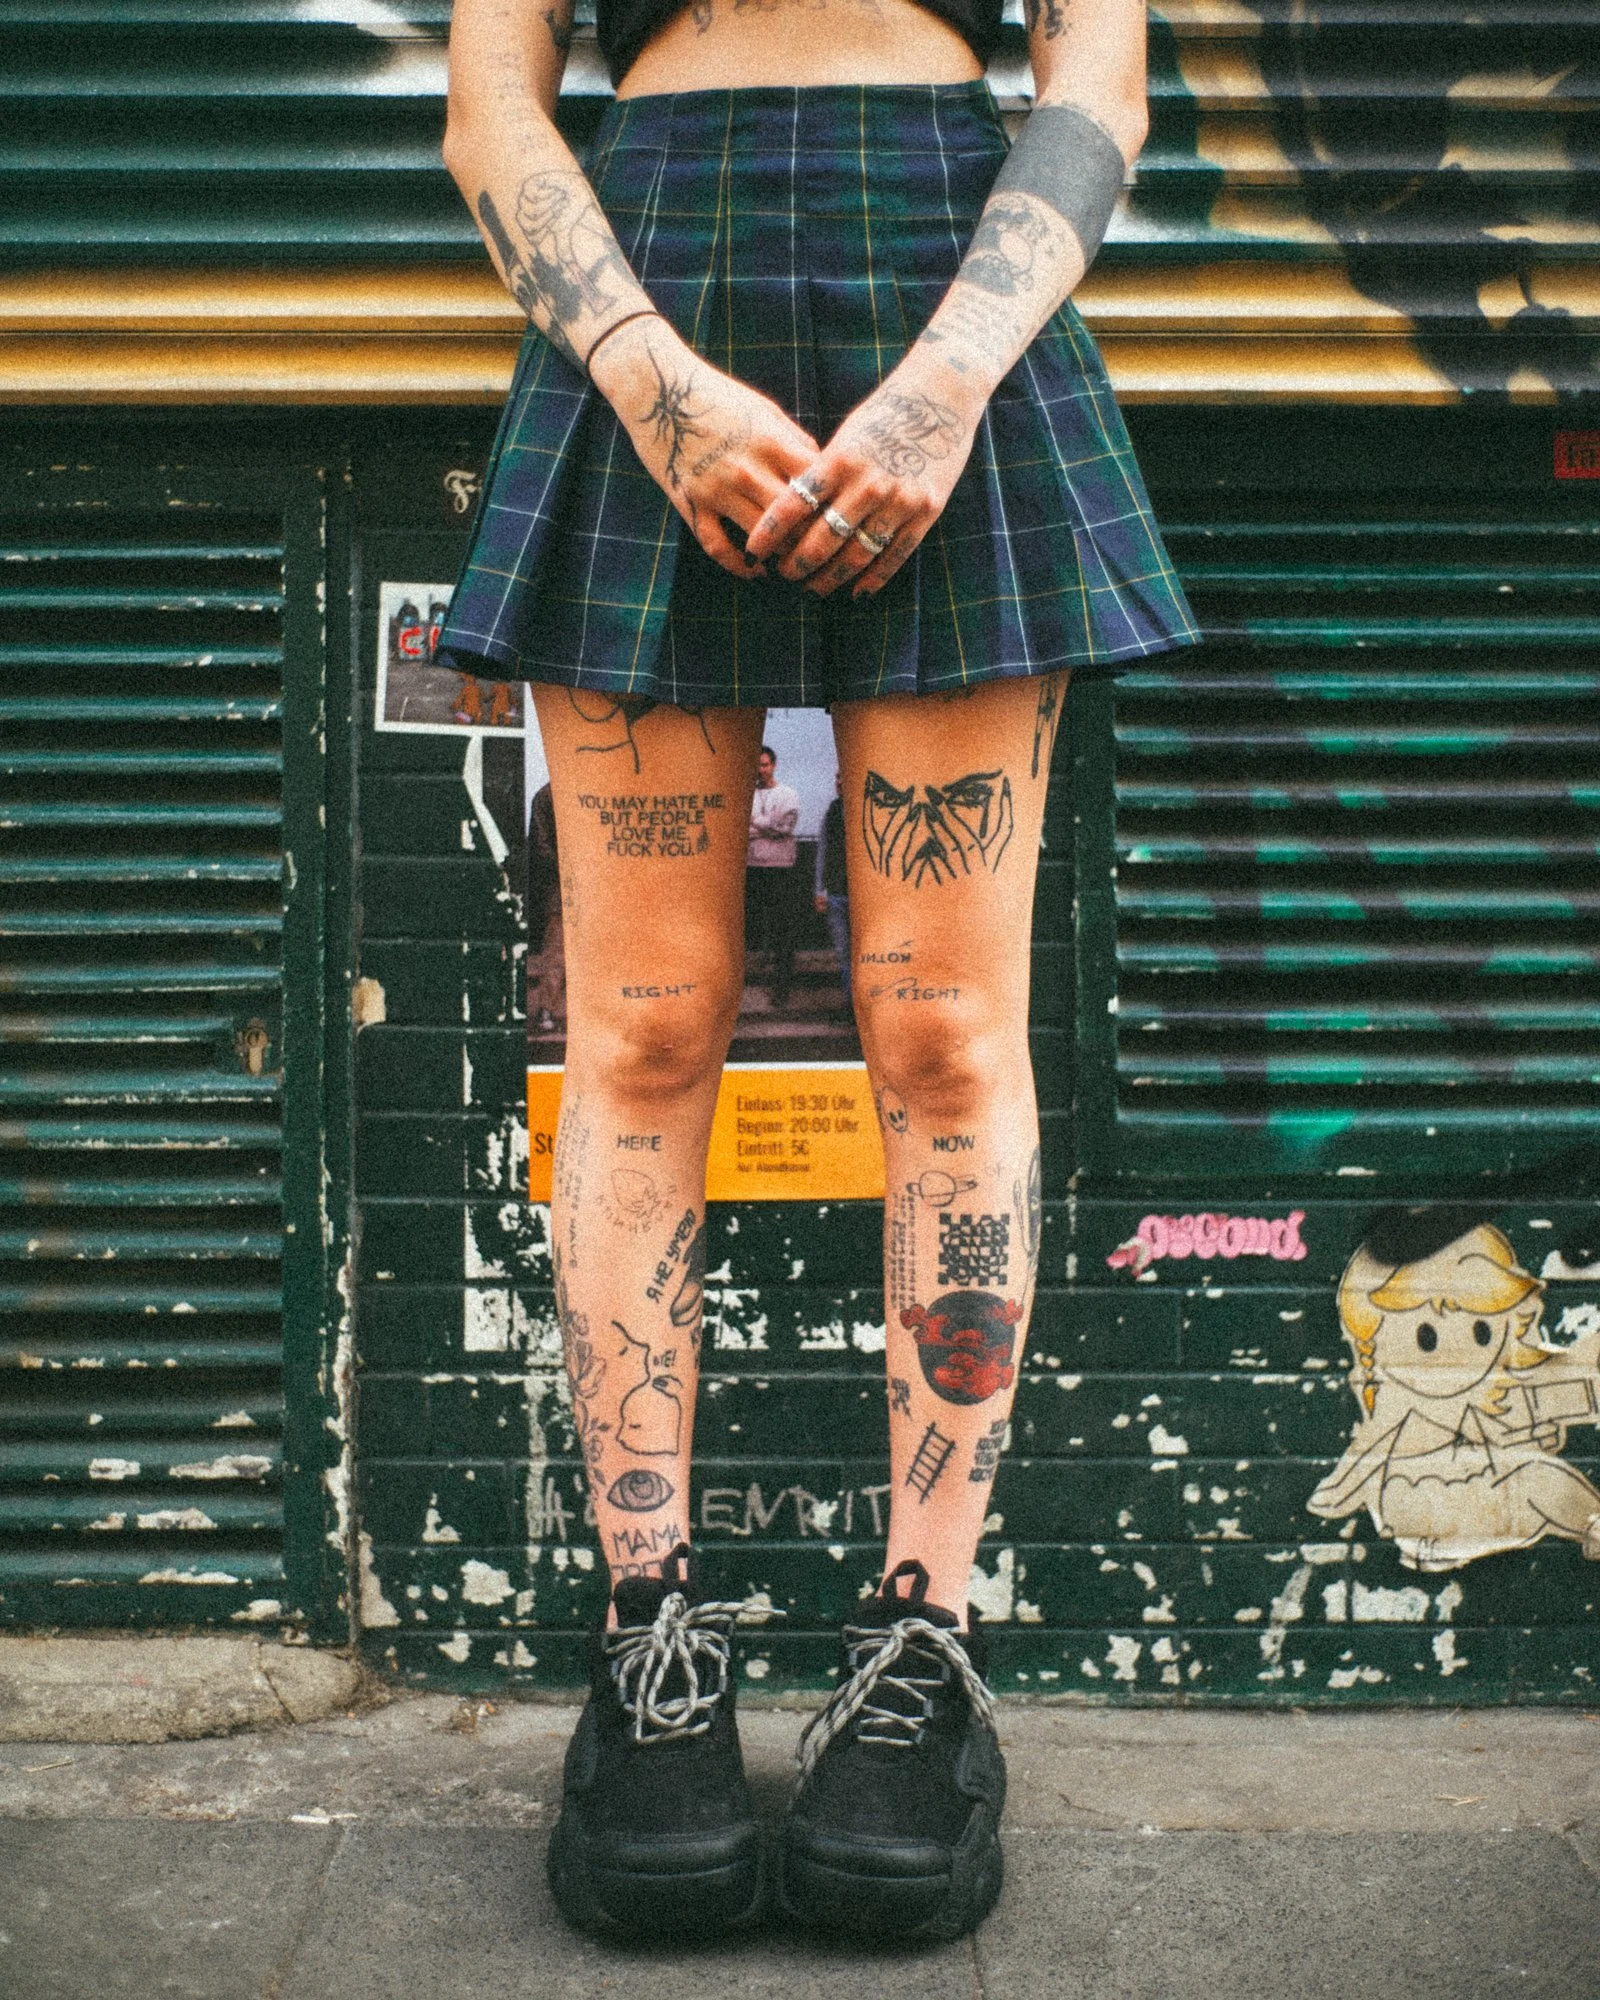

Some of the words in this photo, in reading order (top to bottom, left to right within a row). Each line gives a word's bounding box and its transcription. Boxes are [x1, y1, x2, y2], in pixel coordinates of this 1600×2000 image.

[578, 795, 606, 809] YOU
[612, 796, 646, 810] MAY
[654, 795, 697, 809] HATE
[703, 794, 724, 808] ME
[600, 811, 631, 826] BUT
[638, 810, 704, 826] PEOPLE
[613, 828, 655, 842] LOVE
[607, 843, 652, 856] FUCK
[622, 984, 697, 999] RIGHT
[897, 988, 959, 1000] RIGHT
[832, 1094, 855, 1110] Uhr
[835, 1117, 859, 1133] Uhr
[616, 1134, 662, 1151] HERE
[791, 1139, 809, 1156] 5€
[933, 1136, 975, 1152] NOW
